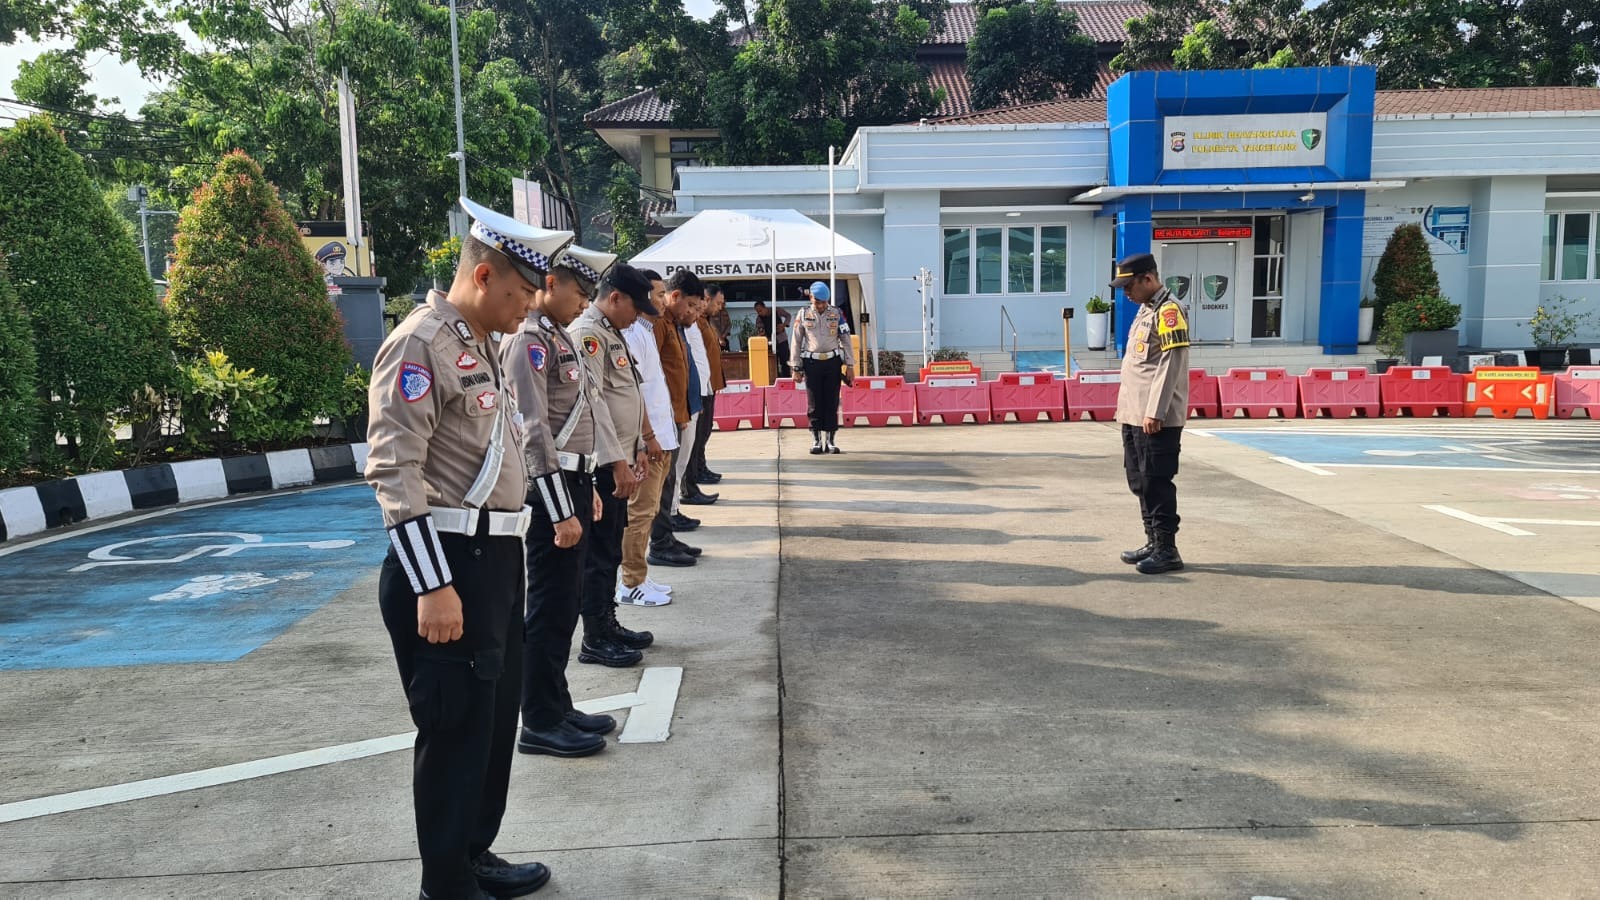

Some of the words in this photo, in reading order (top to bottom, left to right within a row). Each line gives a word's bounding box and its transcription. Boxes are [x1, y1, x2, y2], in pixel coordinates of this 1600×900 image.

[1193, 131, 1223, 140] KLINIK
[1227, 129, 1296, 139] BHAYANGKARA
[1192, 144, 1239, 153] POLRESTA
[1242, 143, 1297, 153] TANGERANG
[746, 260, 837, 274] TANGERANG
[1201, 303, 1229, 311] SIDOKKES
